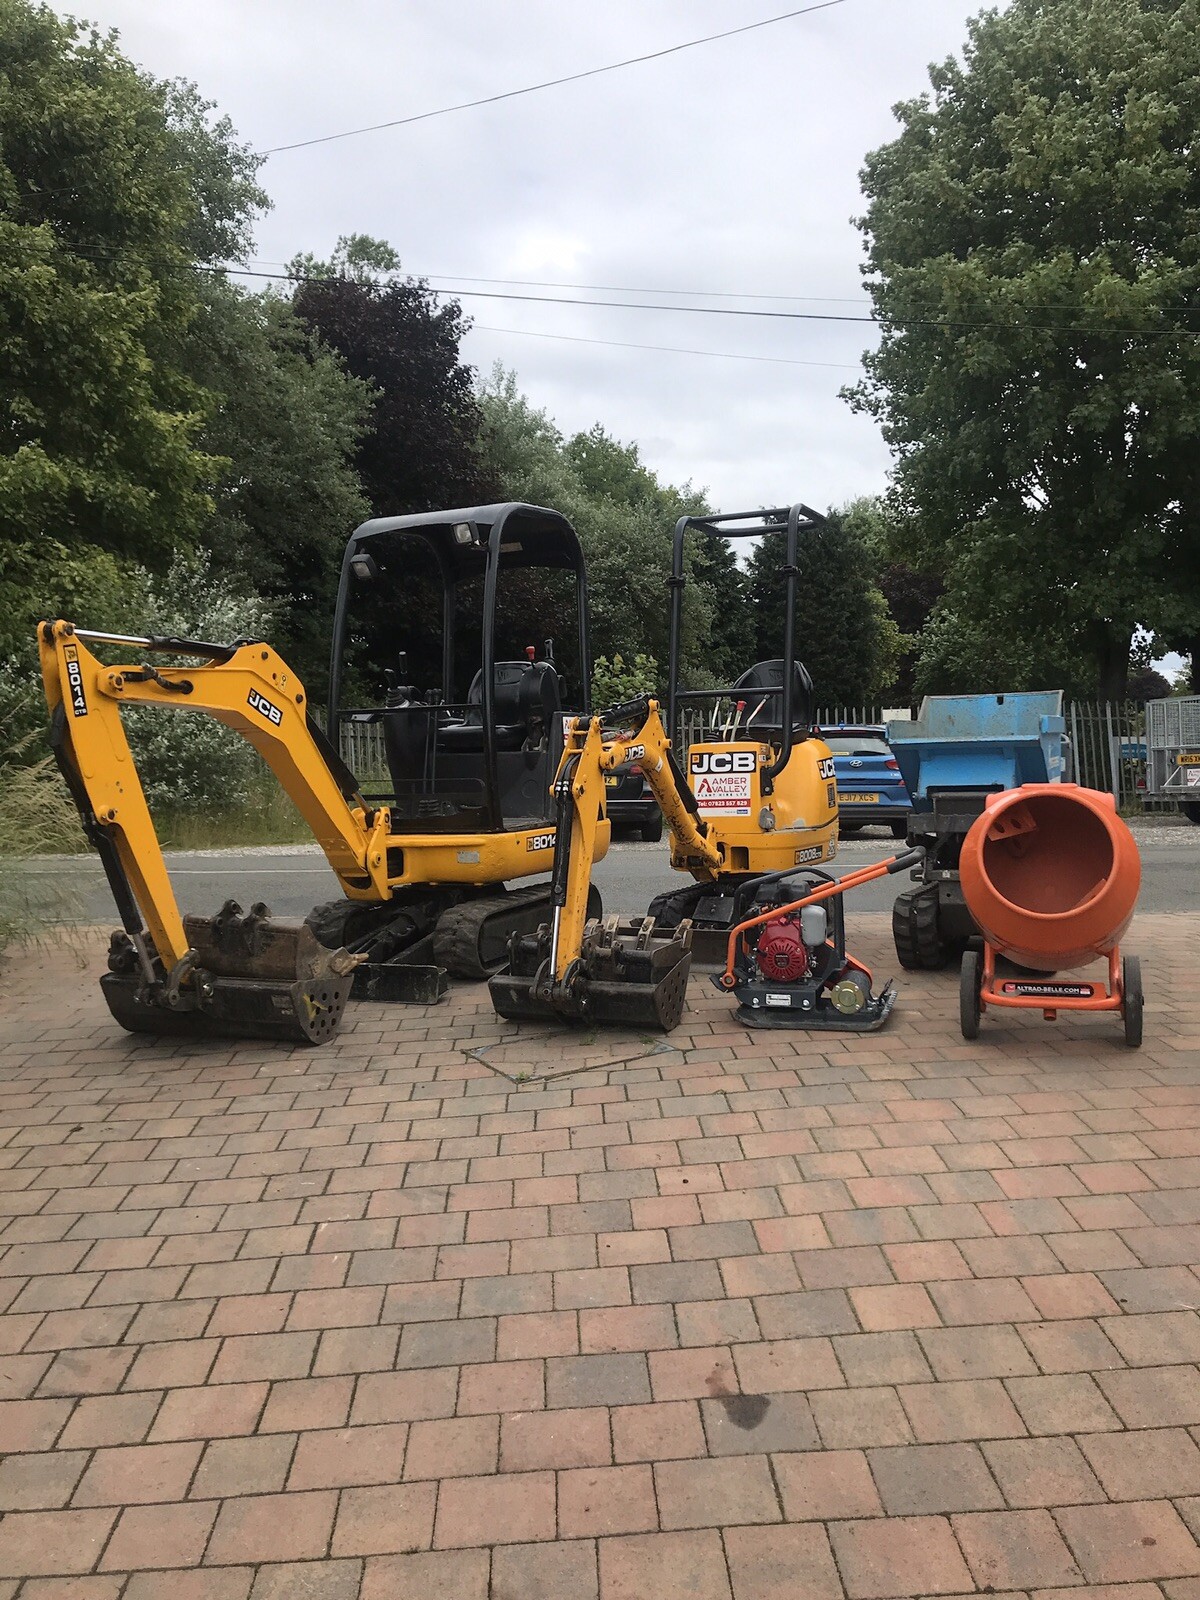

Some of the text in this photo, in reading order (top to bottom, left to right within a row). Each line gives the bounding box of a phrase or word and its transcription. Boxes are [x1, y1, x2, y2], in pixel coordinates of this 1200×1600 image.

[68, 662, 85, 707] 8014
[249, 694, 281, 724] JCB
[625, 745, 645, 762] JCB
[692, 753, 755, 773] JCB
[711, 777, 747, 785] AMBER
[711, 785, 747, 793] VALLEY
[839, 793, 874, 801] EJ17 XCS
